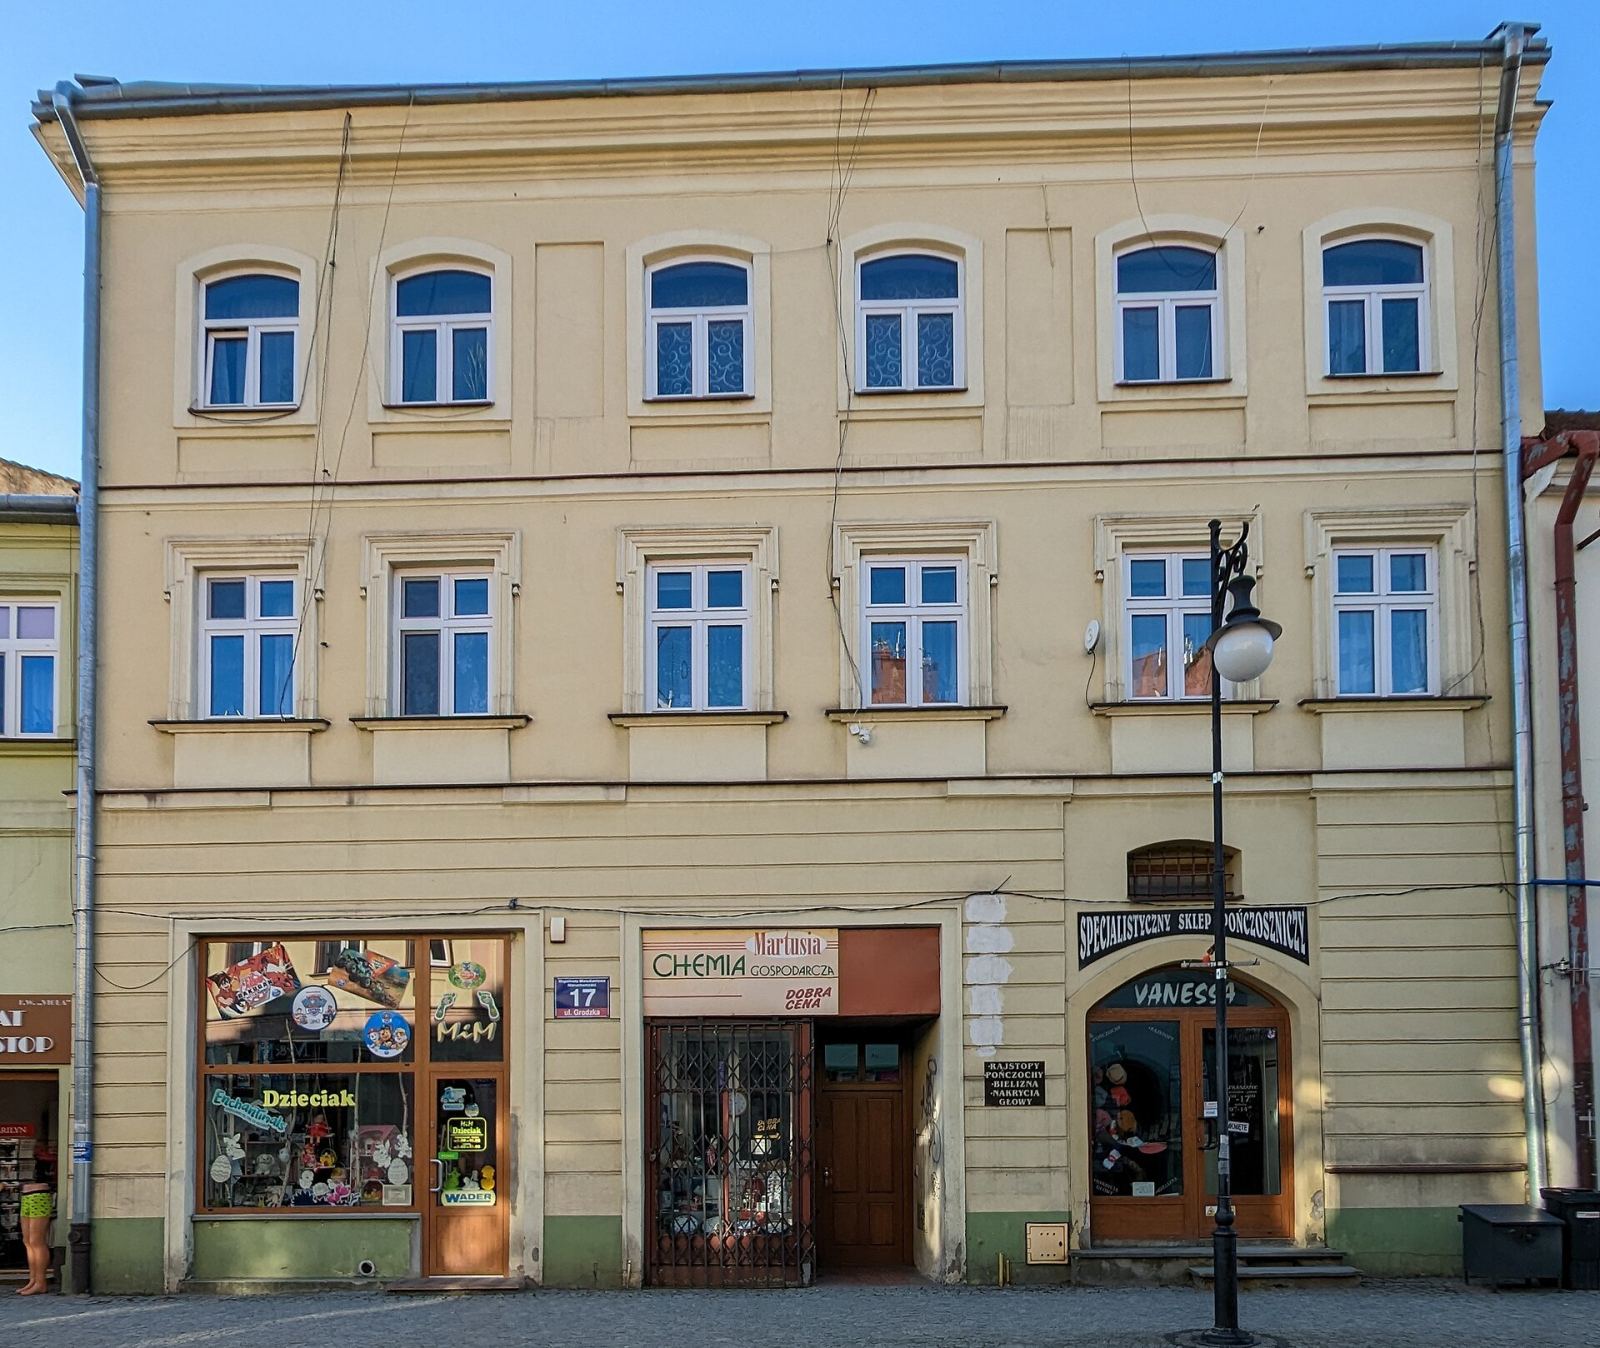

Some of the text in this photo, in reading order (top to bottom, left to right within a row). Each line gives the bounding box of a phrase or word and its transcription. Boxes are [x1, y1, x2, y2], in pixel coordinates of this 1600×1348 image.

[1080, 914, 1171, 960] SPECJALISTYCZNY
[1178, 913, 1211, 930] SKLEP
[754, 931, 821, 956] Martusia
[653, 954, 835, 977] CHEMIA GOSPODARCZA
[570, 988, 596, 1007] 17
[786, 987, 832, 1000] DOBRA
[785, 998, 821, 1010] CENA
[573, 1008, 601, 1016] Grodzka
[437, 1021, 498, 1044] MiM
[990, 1062, 1040, 1070] RAJSTOPY
[985, 1069, 1043, 1079] POŃCZOCHY
[993, 1080, 1039, 1088] BIELIZNA
[263, 1090, 355, 1107] Dzieciak
[452, 1126, 482, 1134] Dzieciak
[445, 1193, 492, 1203] WADER
